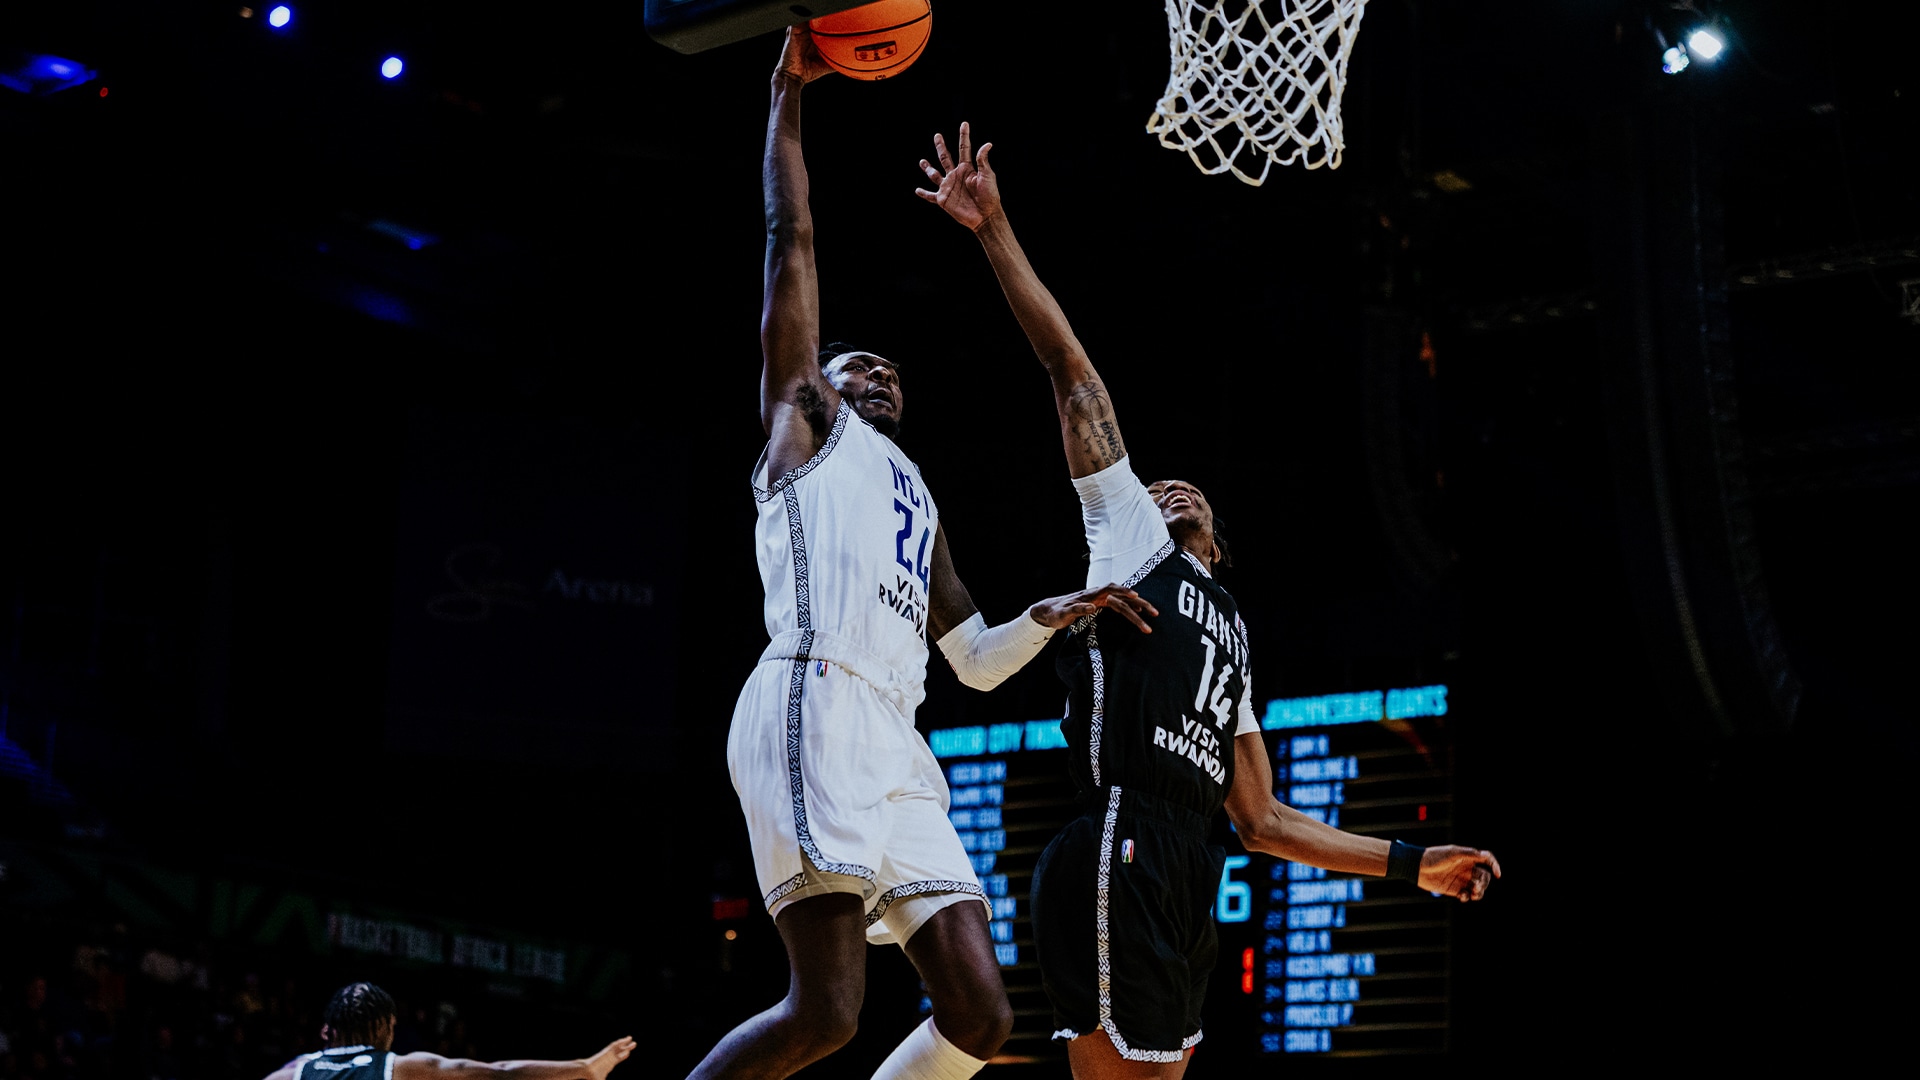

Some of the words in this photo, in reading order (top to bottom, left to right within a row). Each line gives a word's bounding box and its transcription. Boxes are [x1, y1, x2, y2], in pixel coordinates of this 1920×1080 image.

[893, 496, 930, 596] 24
[543, 565, 656, 607] Arena
[878, 582, 925, 642] RWAN
[896, 574, 926, 613] VIST
[1194, 633, 1234, 731] 14
[1153, 725, 1226, 785] RWANDA
